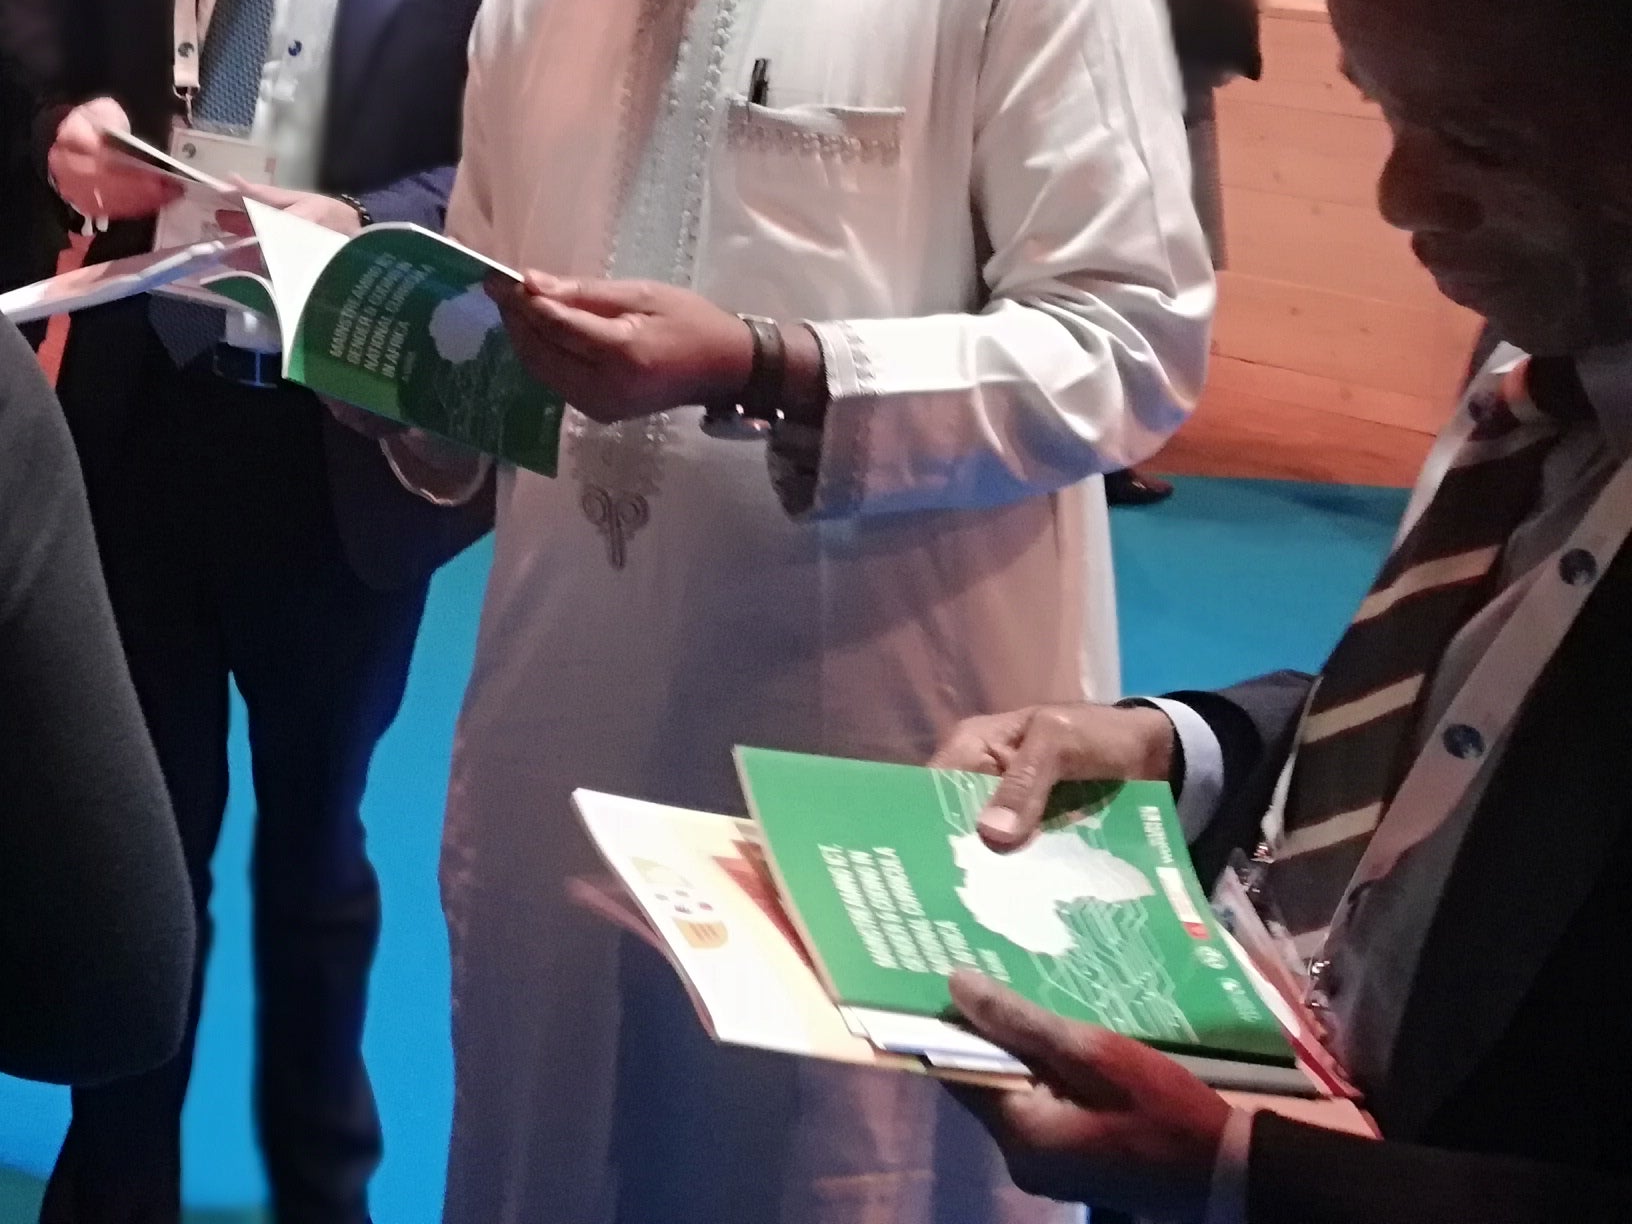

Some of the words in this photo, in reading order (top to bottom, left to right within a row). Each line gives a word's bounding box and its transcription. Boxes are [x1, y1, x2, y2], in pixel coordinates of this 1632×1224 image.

[363, 315, 393, 372] NATIONAL
[384, 321, 411, 365] AFRICA
[381, 362, 396, 378] IN
